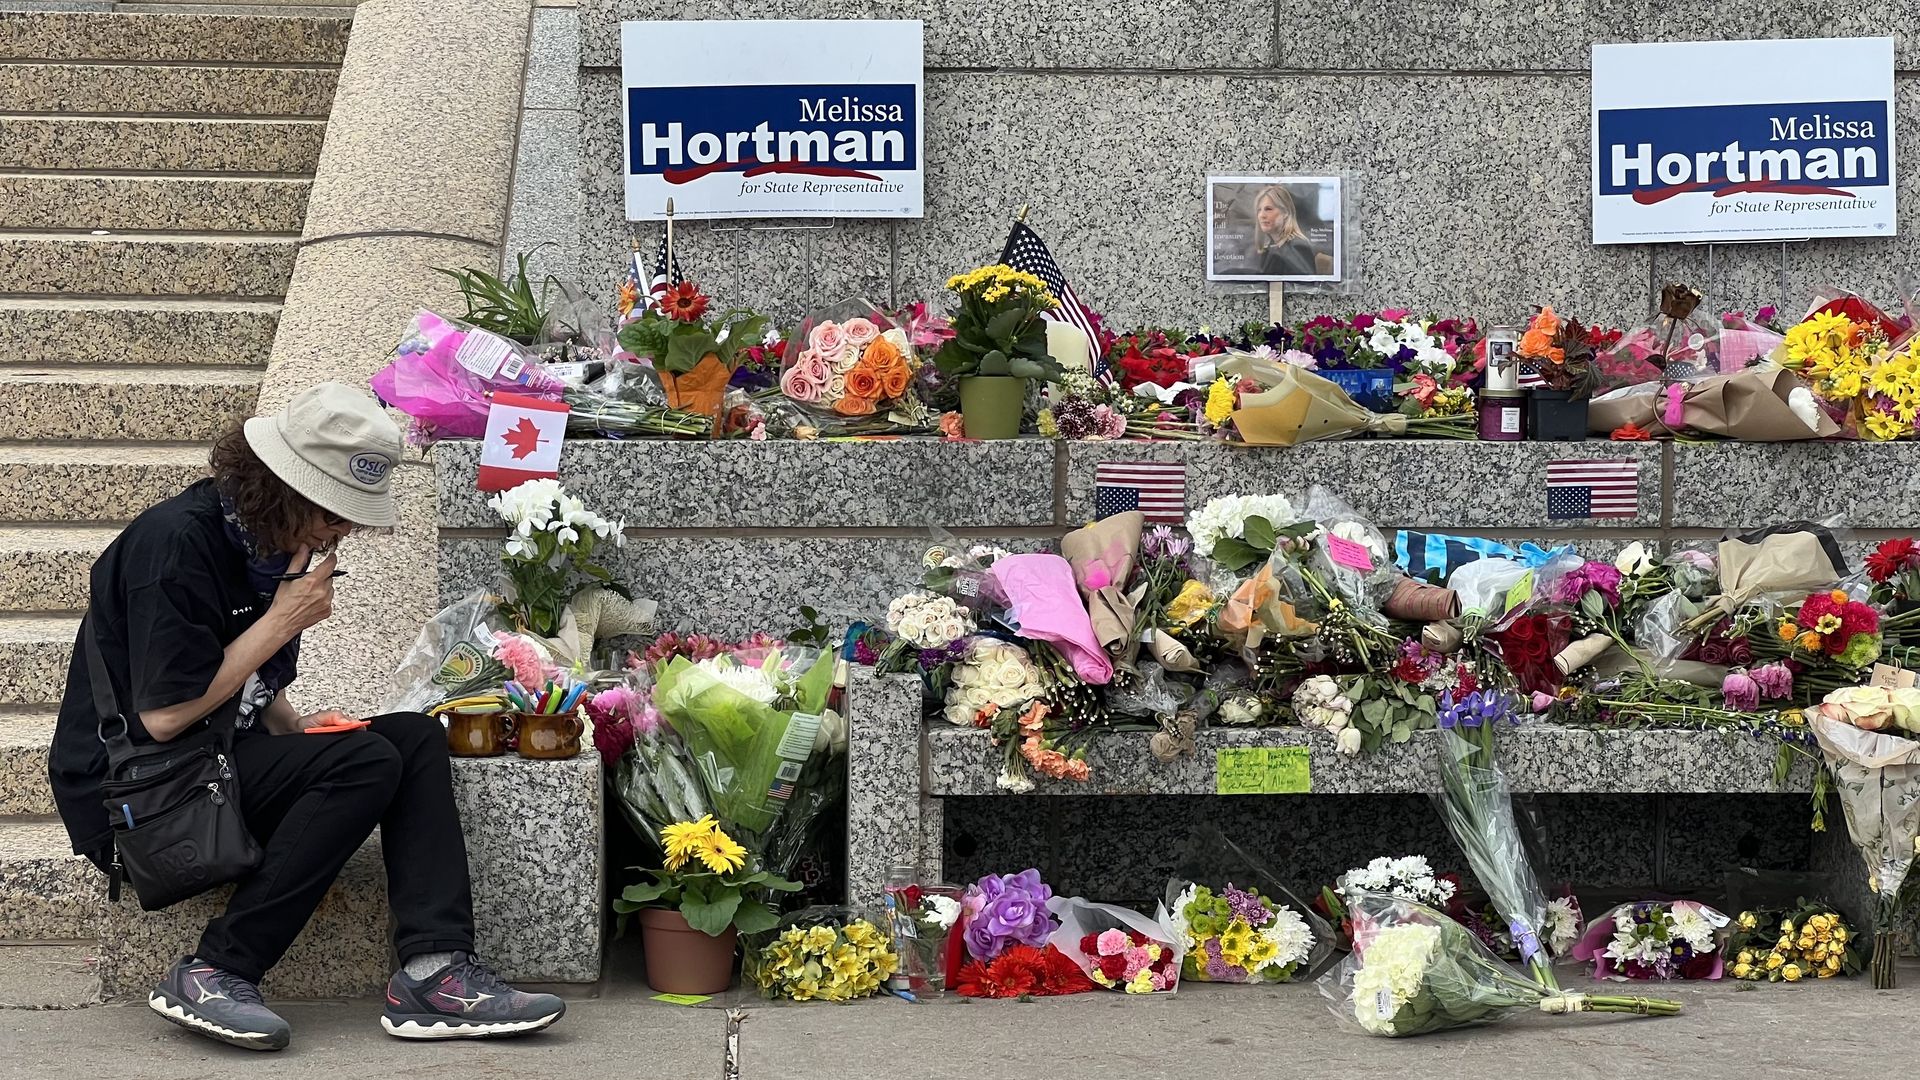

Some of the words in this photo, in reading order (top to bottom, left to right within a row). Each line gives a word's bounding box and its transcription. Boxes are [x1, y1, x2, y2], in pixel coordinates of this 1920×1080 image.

[799, 97, 904, 122] Melissa
[1770, 115, 1875, 141] Melissa
[641, 120, 905, 166] Hortman
[1611, 140, 1877, 187] Hortman
[738, 181, 761, 197] for
[763, 181, 799, 194] State
[802, 180, 904, 196] Representative
[1708, 201, 1732, 217] for
[1734, 200, 1770, 214] State
[1774, 197, 1877, 214] Representative
[357, 458, 386, 473] OSLO
